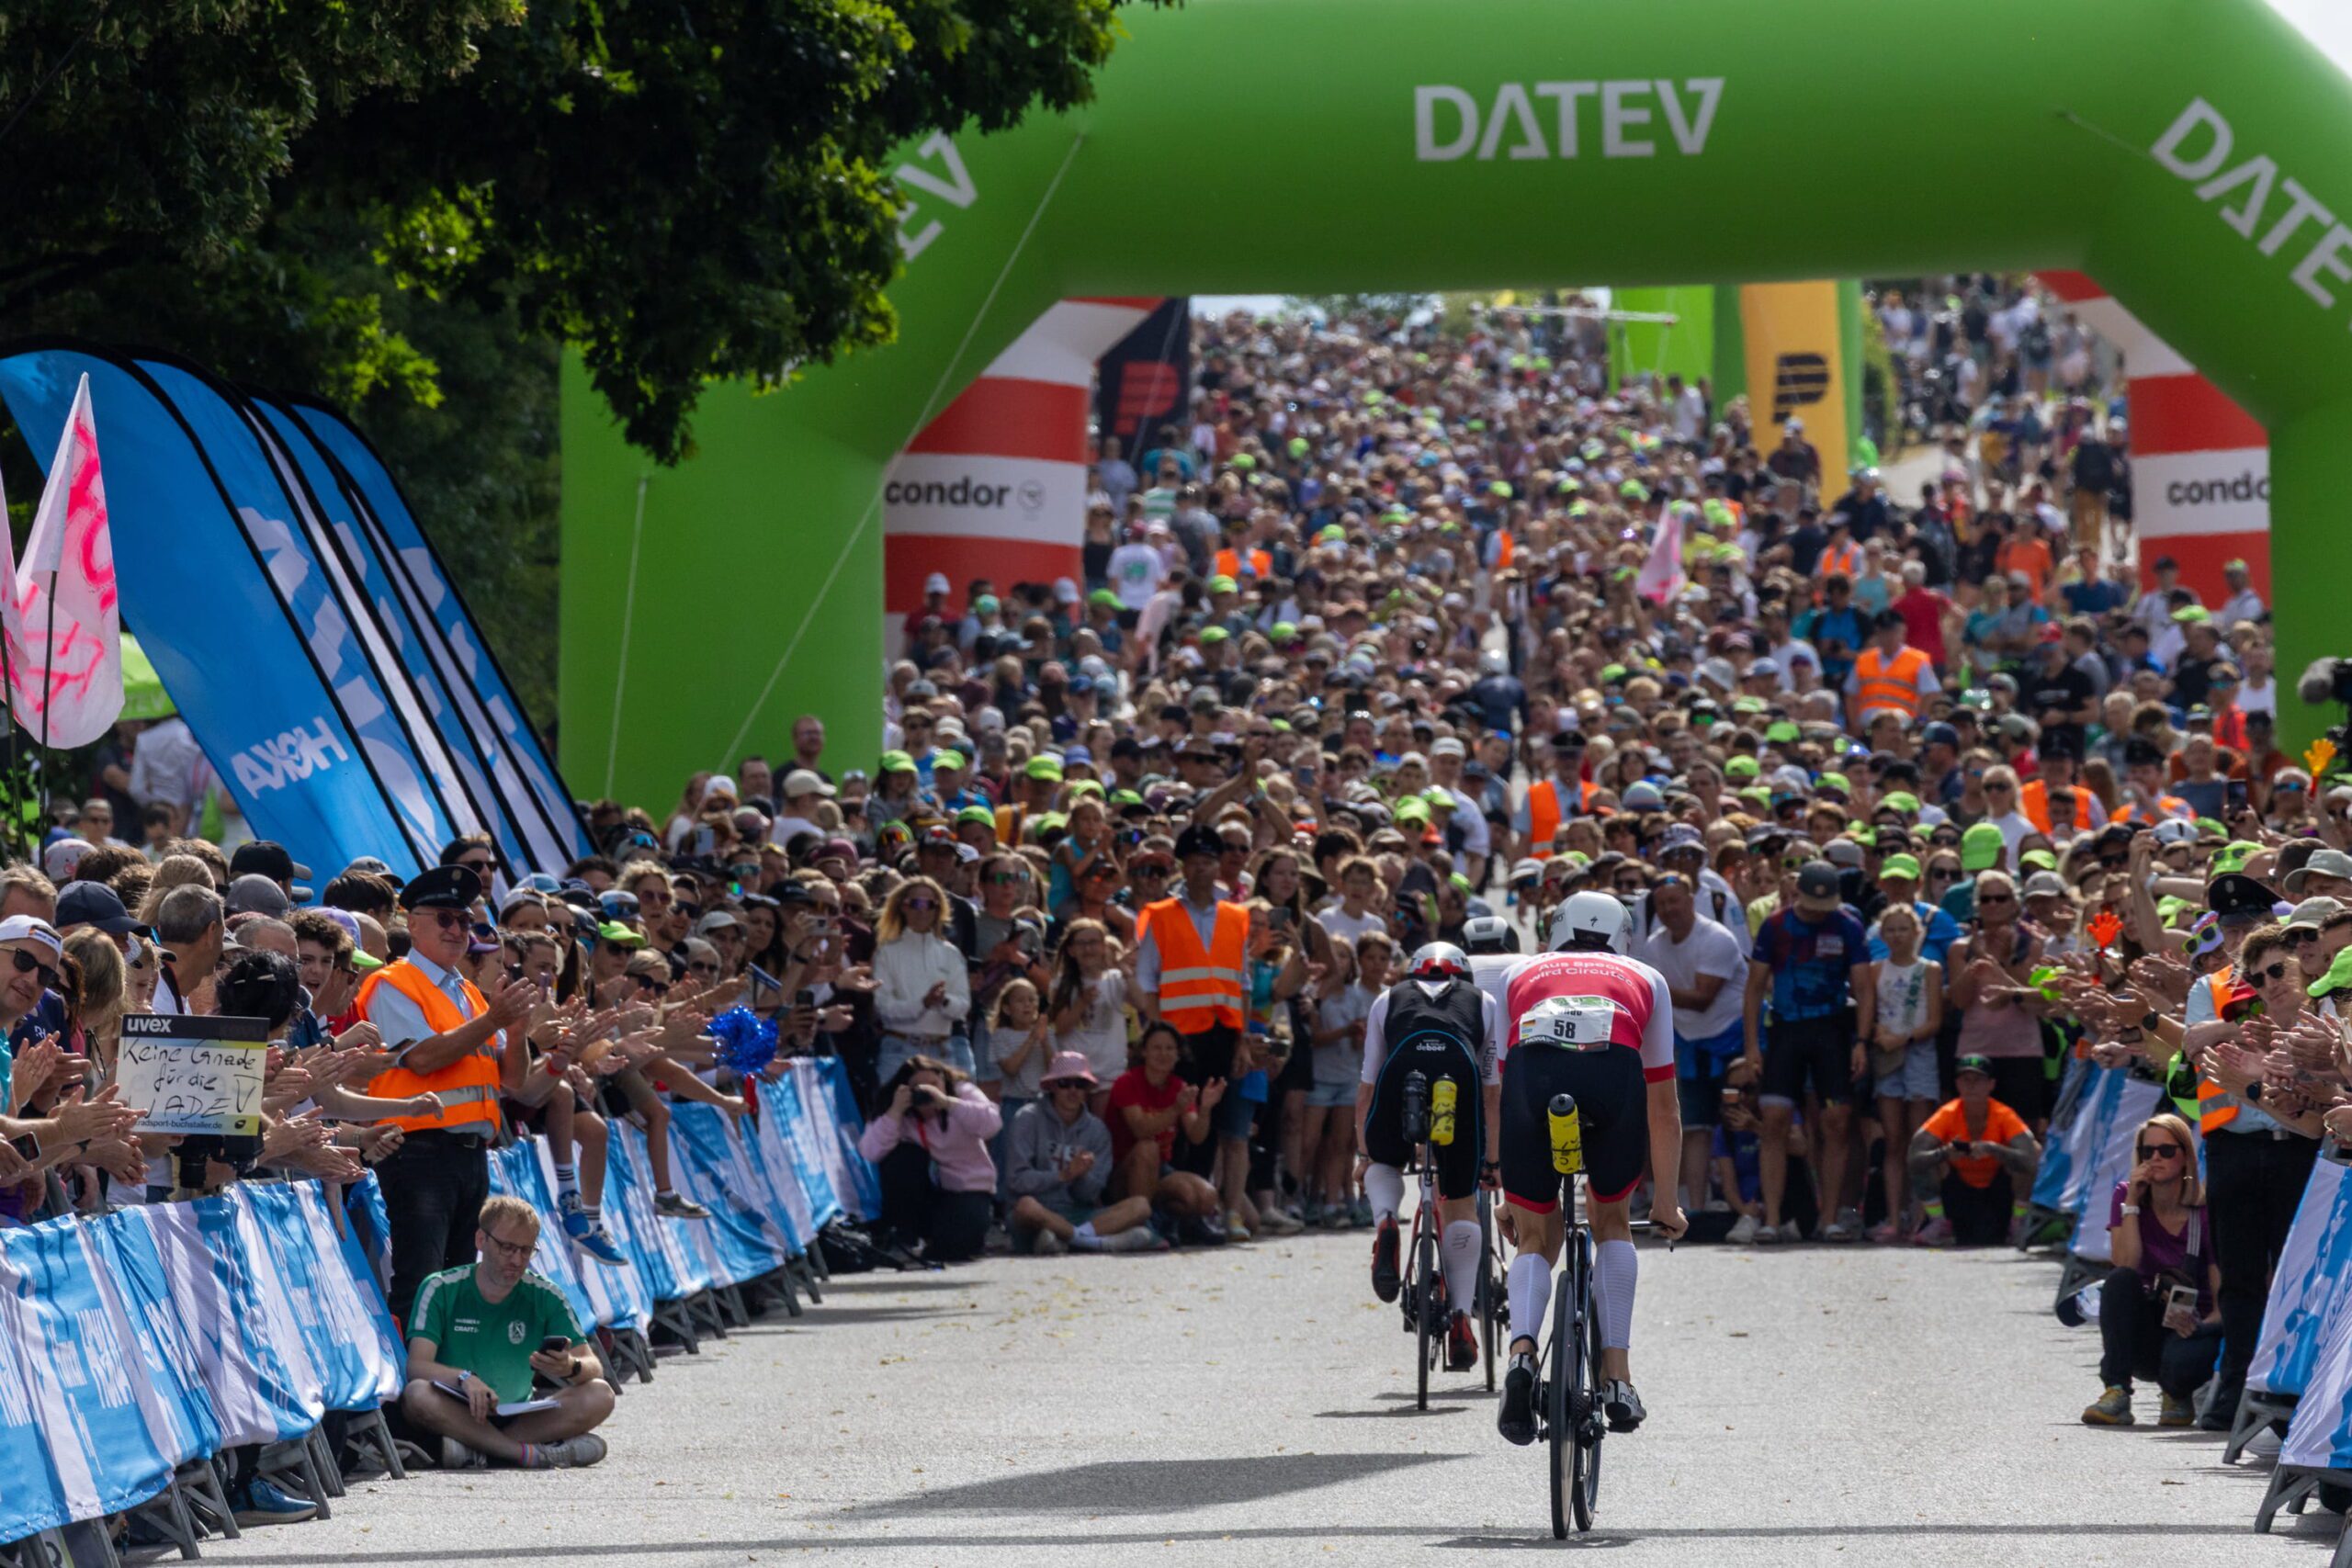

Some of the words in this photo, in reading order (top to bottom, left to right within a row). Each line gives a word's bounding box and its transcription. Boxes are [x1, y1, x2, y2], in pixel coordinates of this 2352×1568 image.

[1413, 77, 1726, 162] DATEV
[2150, 96, 2352, 310] DATE
[884, 475, 1012, 509] condor
[1529, 968, 1562, 983] wird
[1538, 961, 1569, 972] Aus
[127, 1018, 172, 1032] uvex
[1554, 1019, 1577, 1039] 58
[123, 1037, 182, 1065] Keine
[153, 1063, 185, 1091] für
[187, 1071, 219, 1090] die
